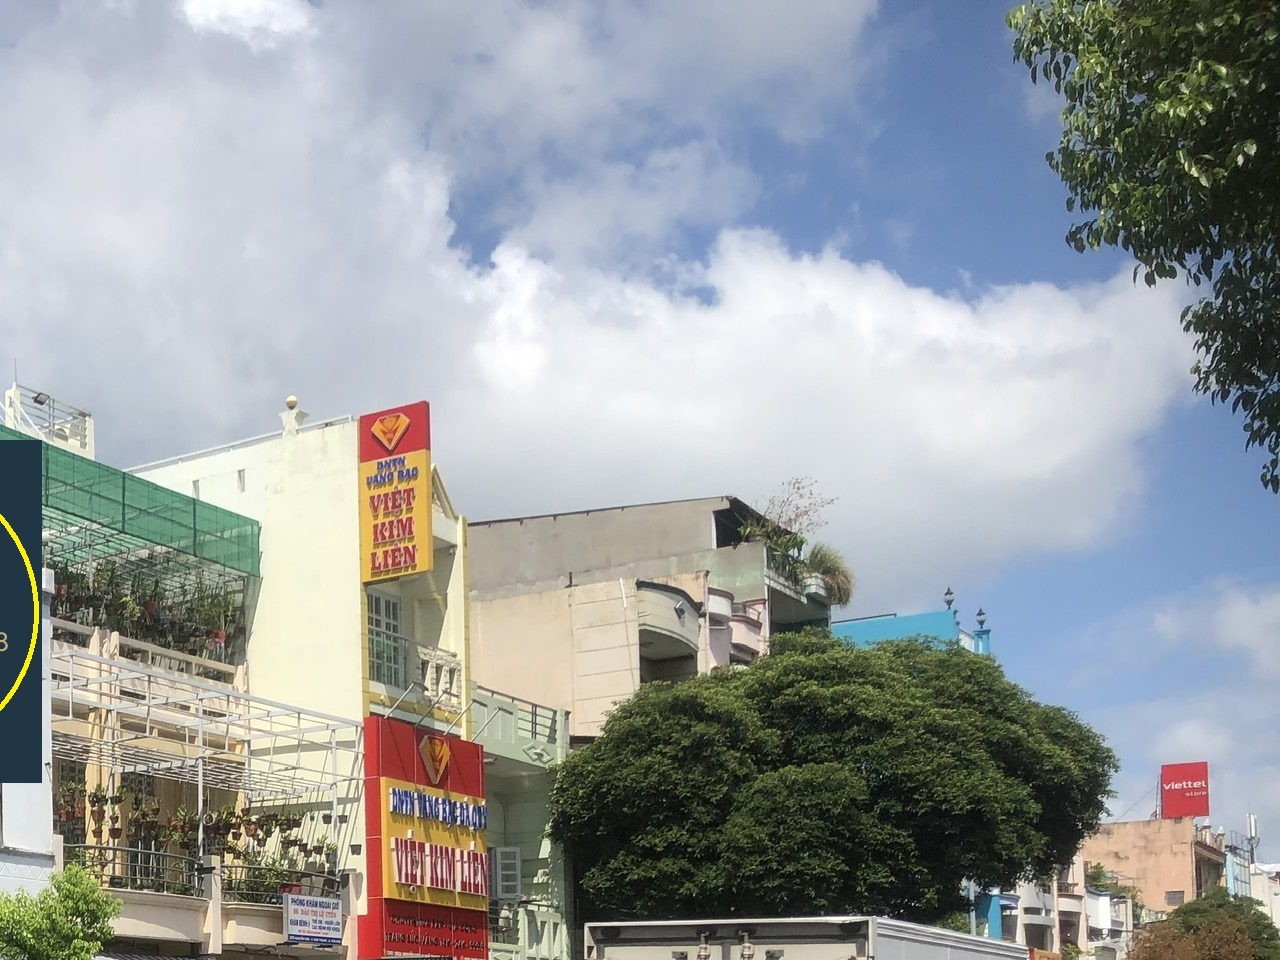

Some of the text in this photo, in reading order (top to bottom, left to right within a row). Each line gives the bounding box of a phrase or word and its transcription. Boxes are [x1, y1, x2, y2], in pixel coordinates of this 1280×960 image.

[376, 456, 407, 471] DNTN
[369, 486, 416, 516] VIỆT
[372, 516, 415, 544] KIM
[370, 541, 418, 573] LIÊN
[1163, 780, 1207, 790] viettel
[391, 830, 488, 897] VIỆT KIM LIÊN
